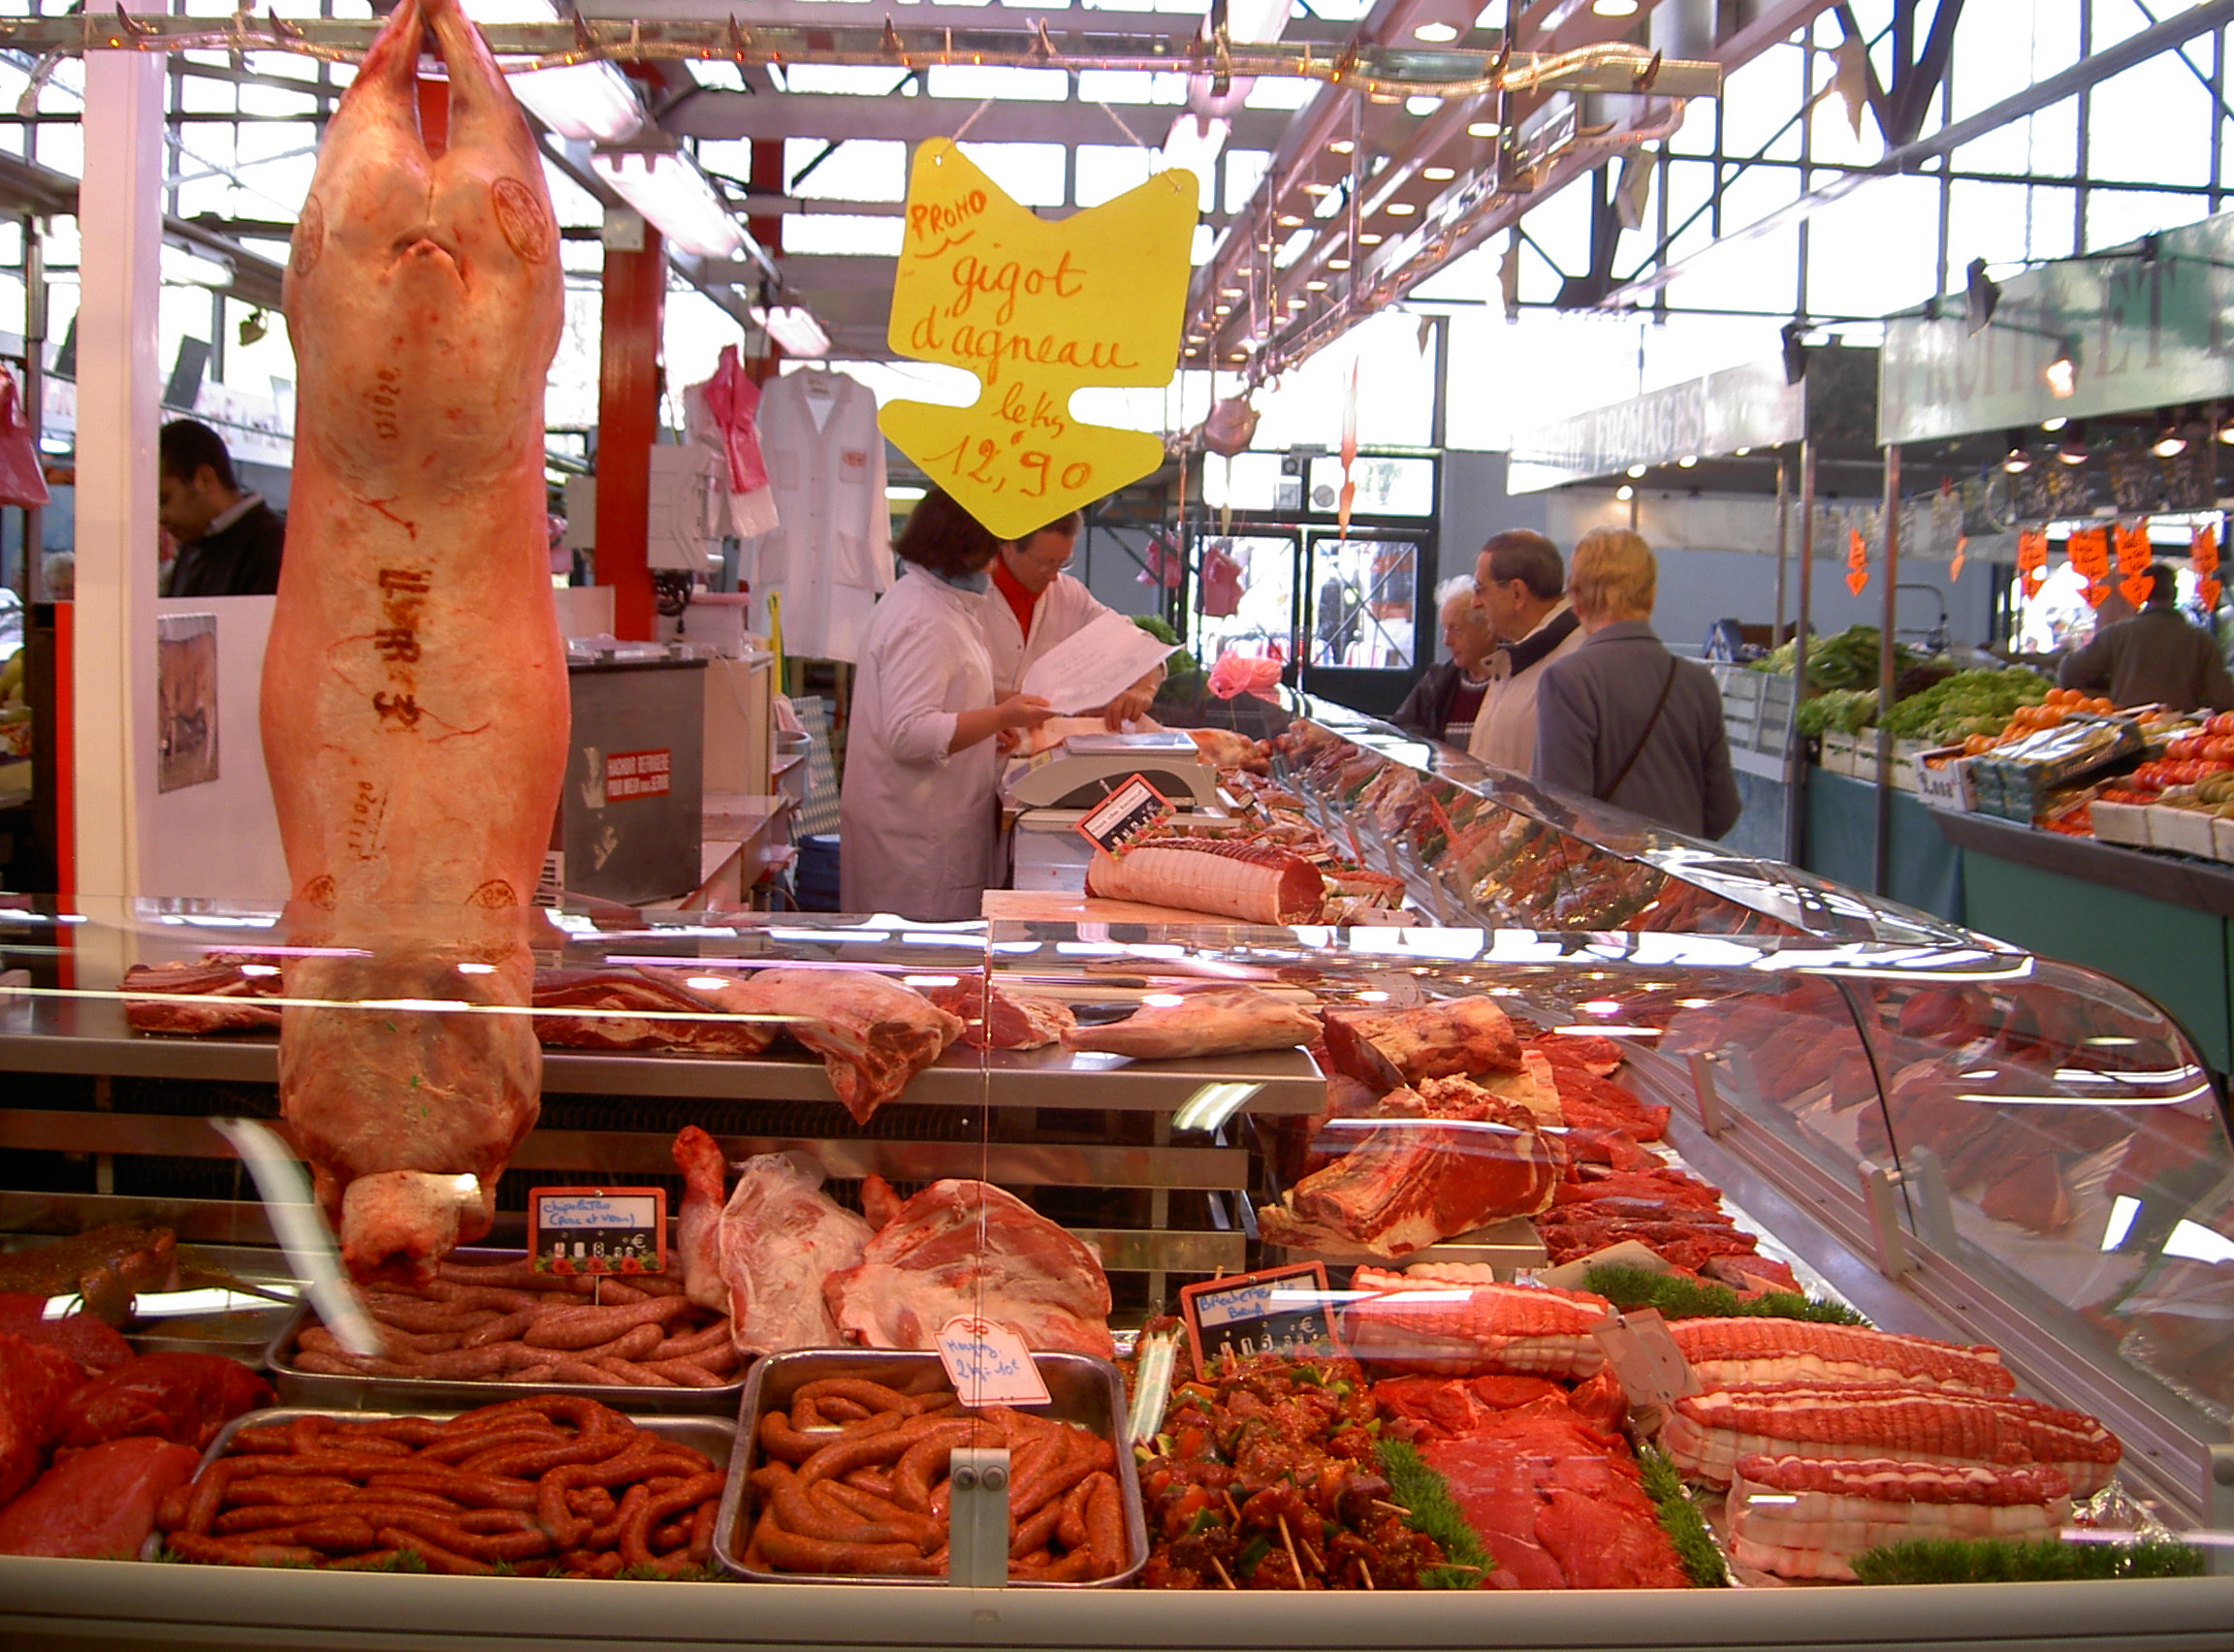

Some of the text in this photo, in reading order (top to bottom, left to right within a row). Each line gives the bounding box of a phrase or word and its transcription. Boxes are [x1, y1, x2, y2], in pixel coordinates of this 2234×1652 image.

[910, 188, 988, 243] PROMO
[951, 242, 1088, 327] gigot
[910, 304, 1141, 387] d'agneau
